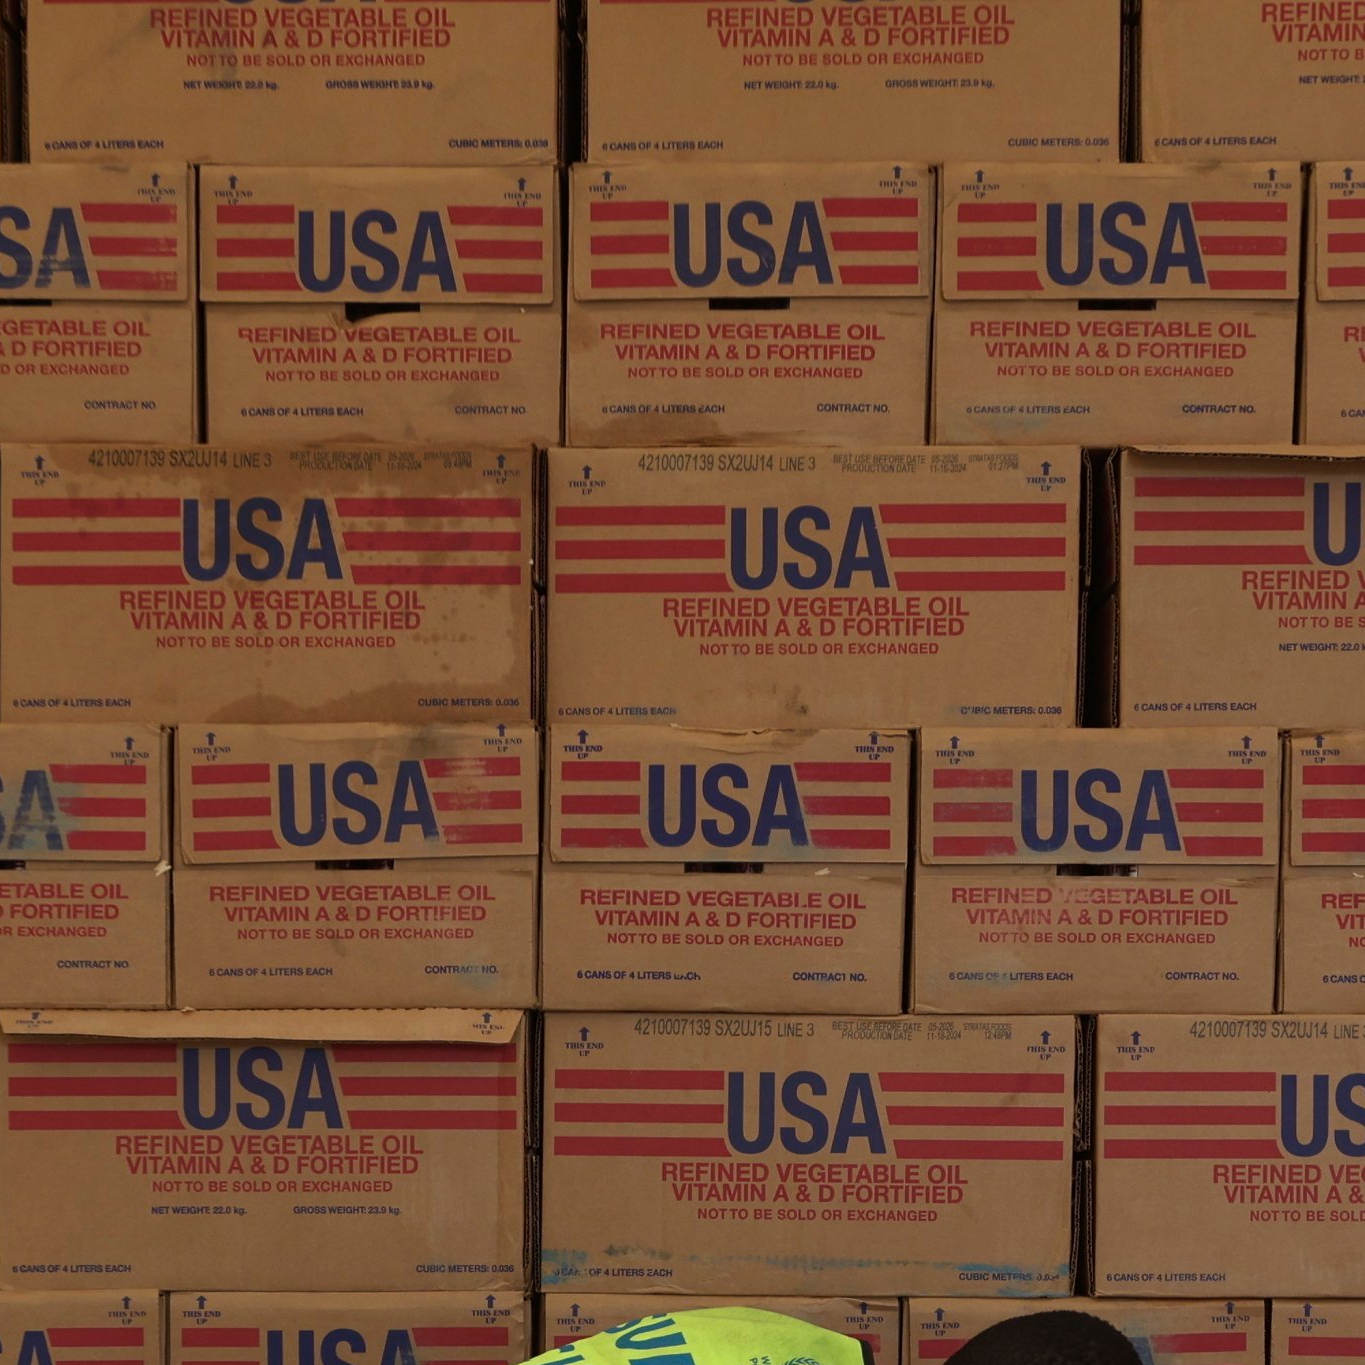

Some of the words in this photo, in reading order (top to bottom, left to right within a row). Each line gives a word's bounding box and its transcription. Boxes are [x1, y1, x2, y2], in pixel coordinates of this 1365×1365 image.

[300, 211, 454, 291] USA
[1047, 203, 1204, 285] USA
[600, 324, 701, 340] REFINED
[706, 324, 841, 340] VEGETABLE
[846, 324, 885, 341] OIL
[638, 454, 715, 472] 4210007139
[779, 456, 805, 472] LINE
[808, 456, 816, 471] 3
[733, 507, 887, 589] USA
[648, 764, 808, 847] USA
[1322, 975, 1329, 984] 6
[1330, 975, 1358, 984] CANS
[634, 1018, 712, 1036] 4210007139
[714, 1020, 772, 1038] SX2UJ15
[777, 1022, 803, 1038] LINE
[806, 1022, 815, 1038] 3
[832, 1021, 855, 1031] BEST
[856, 1021, 872, 1031] USE
[873, 1021, 903, 1031] BEFORE
[903, 1022, 922, 1031] DATE
[842, 1031, 893, 1040] PRODUCTION
[894, 1031, 913, 1041] DATE
[565, 1042, 584, 1050] THIS
[587, 1042, 604, 1050] END
[579, 1049, 590, 1057] UP
[729, 1072, 885, 1154] USA
[660, 1161, 769, 1183] REFINED
[776, 1163, 920, 1185] VEGETABLE
[927, 1165, 969, 1185] OIL
[671, 1182, 766, 1203] VITAMIN
[772, 1183, 790, 1203] A
[795, 1184, 812, 1203] &
[818, 1184, 836, 1203] D
[841, 1184, 964, 1204] FORTIFIED
[697, 1208, 729, 1220] NOT
[731, 1208, 749, 1220] TO
[753, 1208, 773, 1220] BE
[777, 1209, 816, 1221] SOLD
[821, 1209, 842, 1221] OR
[847, 1209, 938, 1222] EXCHANGED
